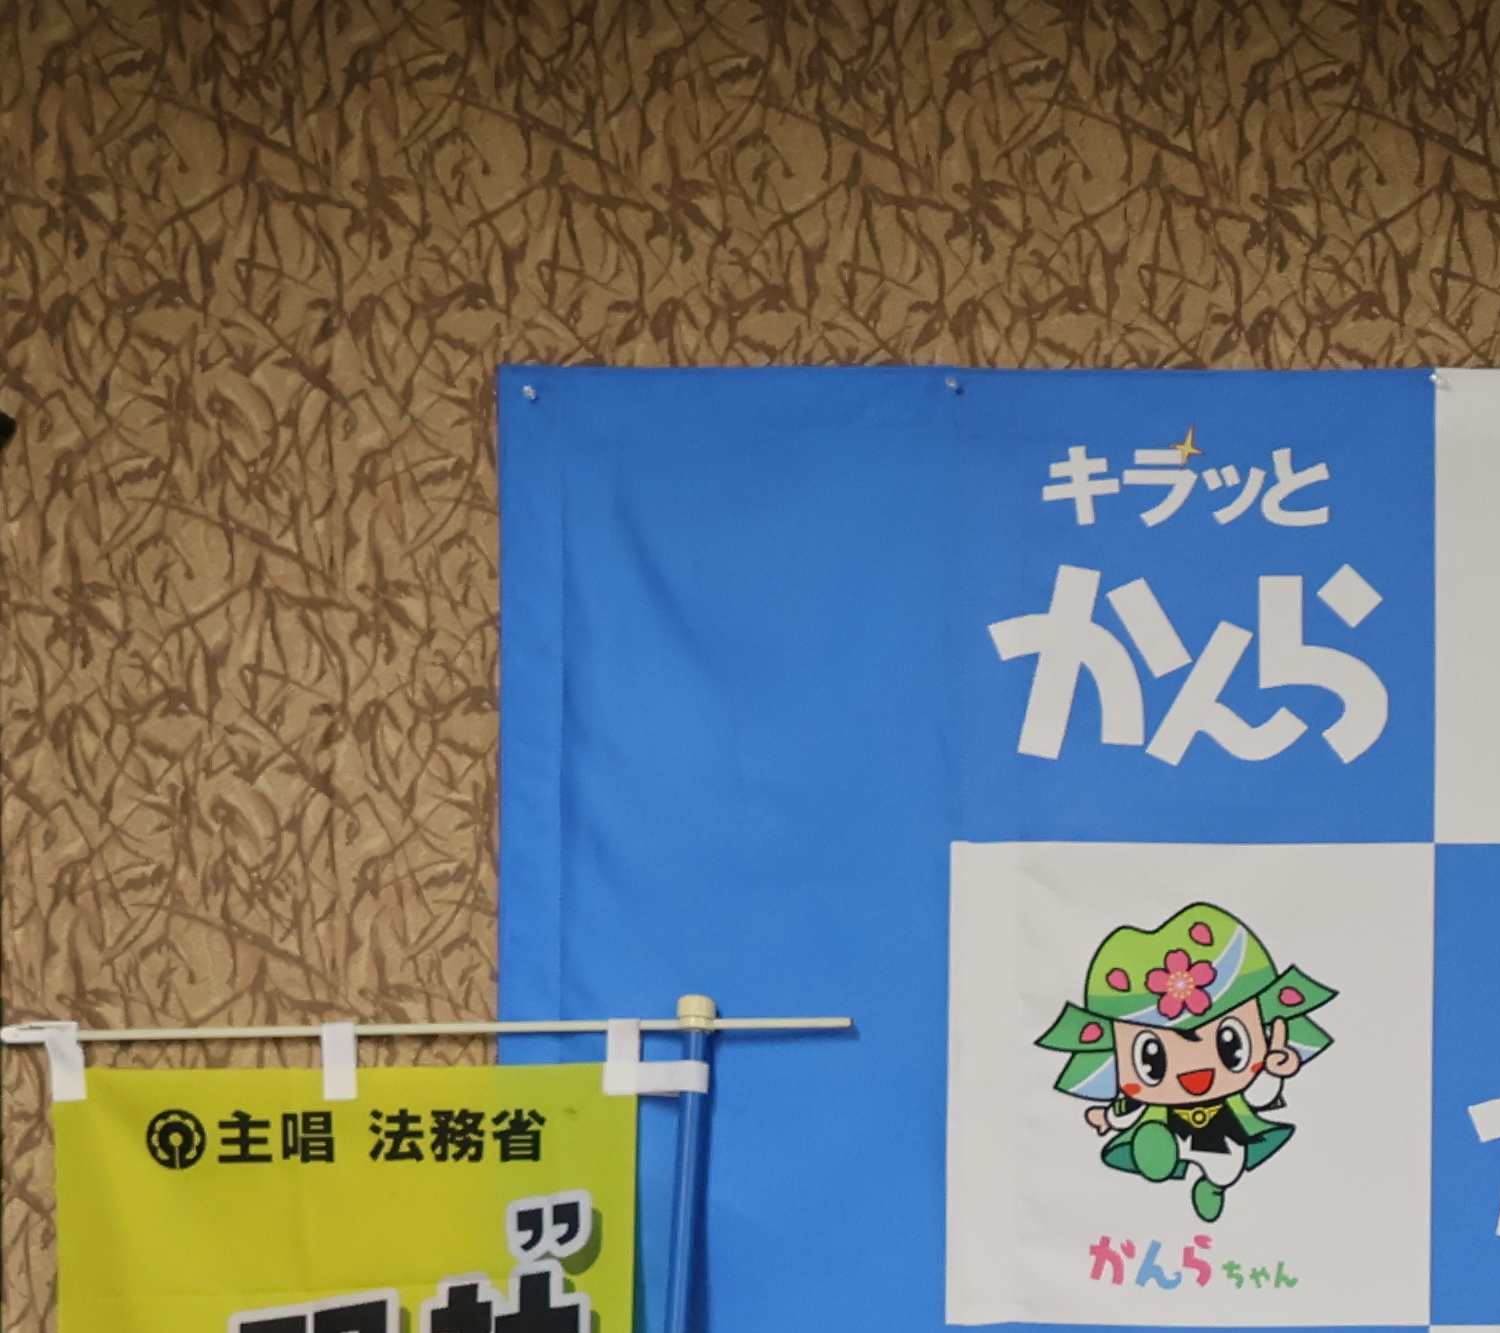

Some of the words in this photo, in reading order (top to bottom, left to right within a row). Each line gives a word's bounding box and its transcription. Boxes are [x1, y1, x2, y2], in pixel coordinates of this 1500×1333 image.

[1043, 445, 1329, 526] キラッと
[989, 565, 1388, 765] かんら
[218, 1110, 334, 1164] 主唱
[369, 1108, 546, 1163] 法務省
[1090, 1235, 1295, 1289] かんらちゃん
